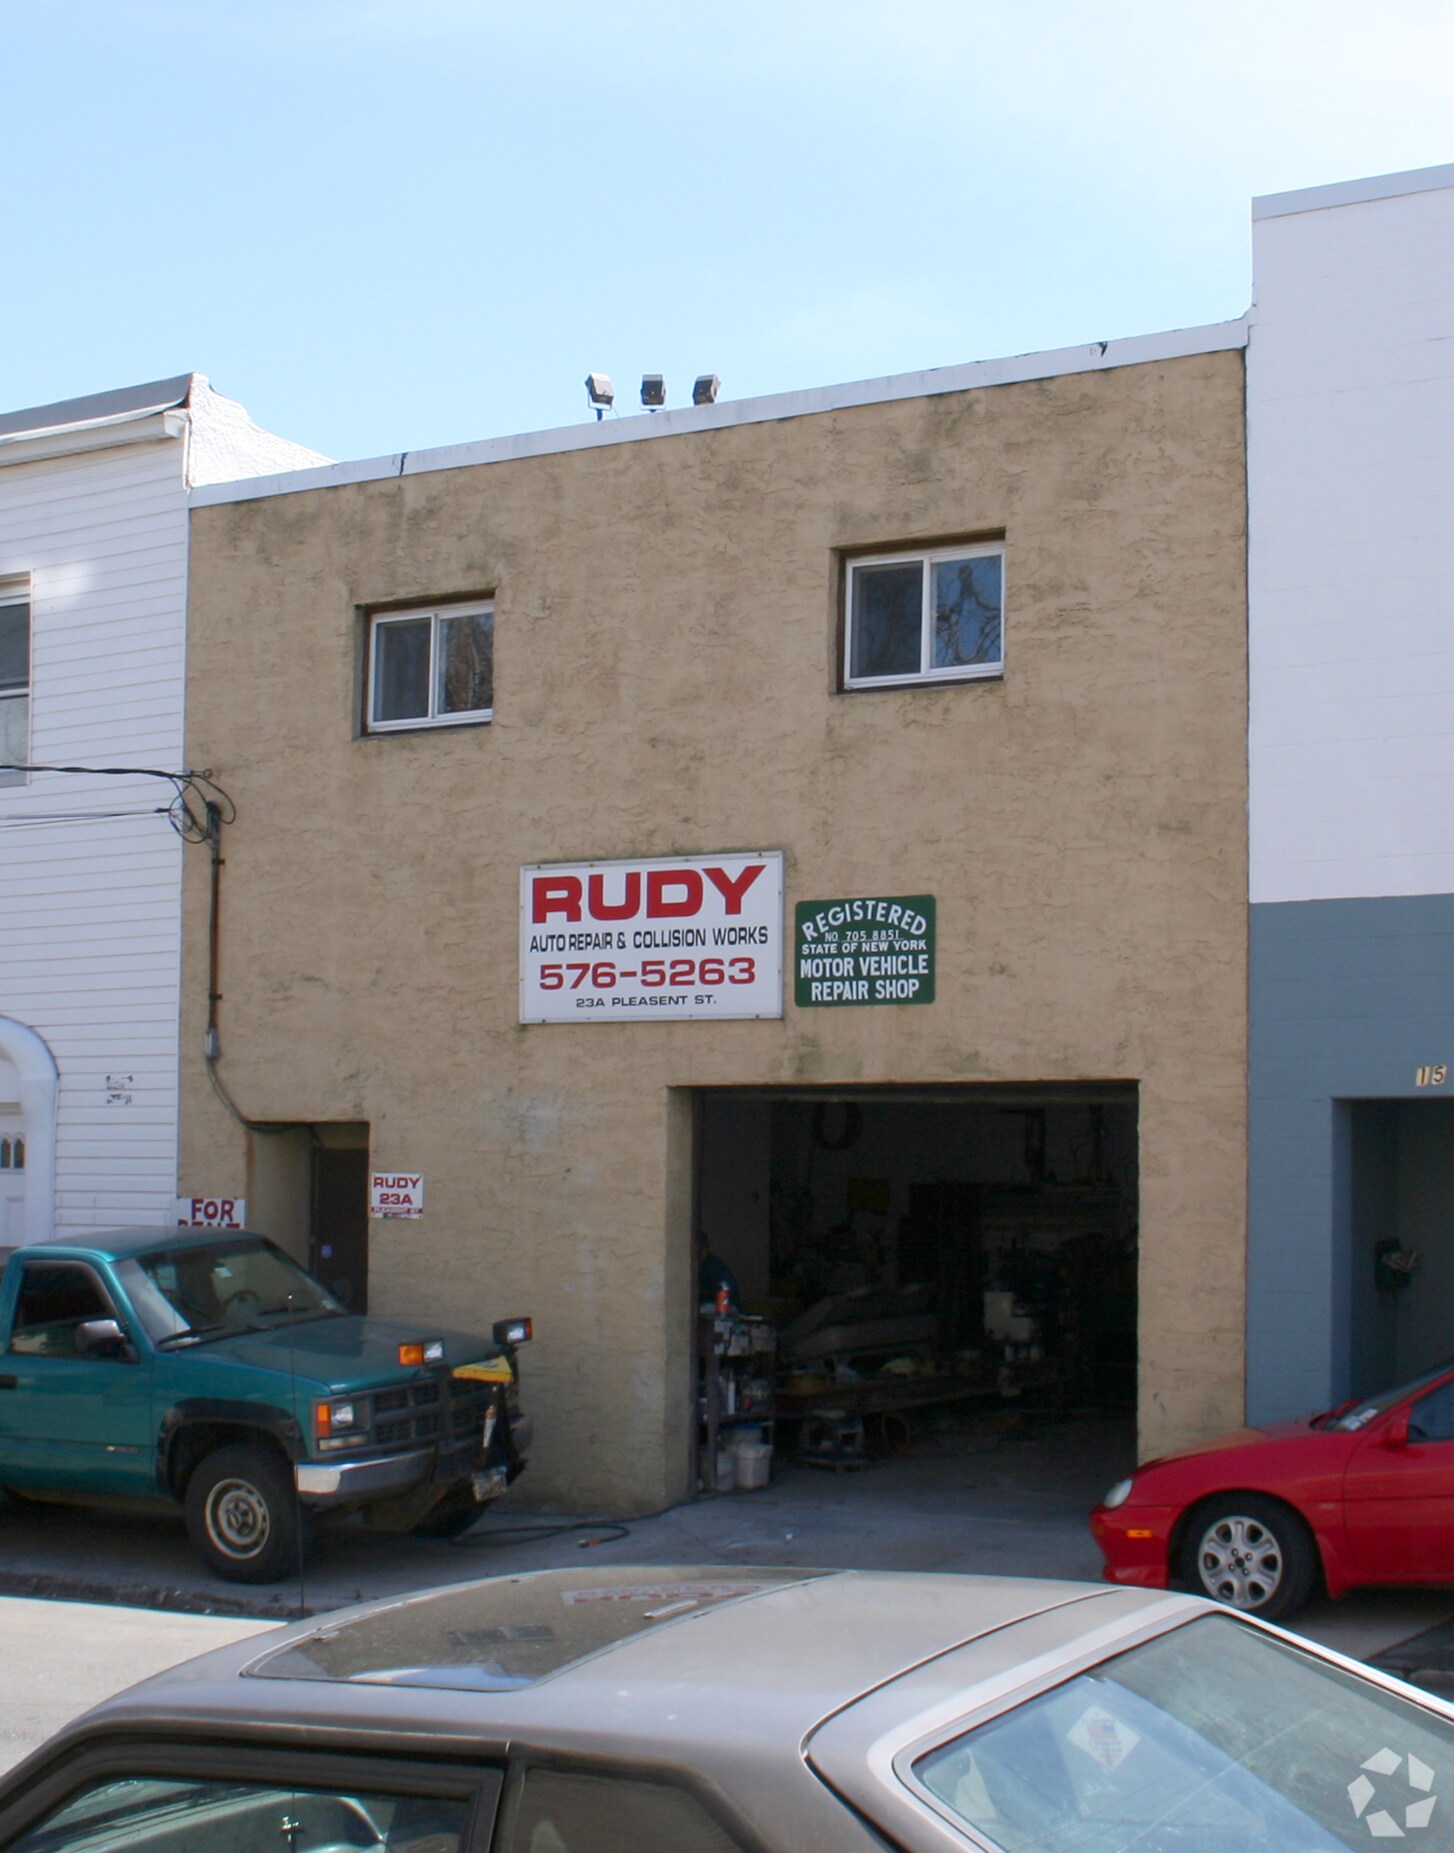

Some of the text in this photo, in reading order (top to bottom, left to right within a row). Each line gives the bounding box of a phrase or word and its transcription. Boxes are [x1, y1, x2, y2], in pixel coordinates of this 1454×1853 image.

[532, 865, 767, 924] RUDY
[801, 900, 928, 942] REGISTERED
[530, 926, 769, 953] AUTO REPAIR & COLLISION WORKS
[801, 939, 927, 955] STATE OF NEW YORK
[846, 931, 867, 941] 705
[872, 929, 900, 941] 8851
[539, 957, 756, 990] 576-5263
[800, 954, 929, 979] MOTOR VEHICLE
[576, 994, 717, 1008] 23A PLEASENT ST.
[811, 978, 920, 1002] REPAIR SHOP
[1421, 1065, 1444, 1085] 15
[373, 1176, 421, 1189] RUDY
[192, 1198, 234, 1223] FOR
[379, 1193, 413, 1205] 23A
